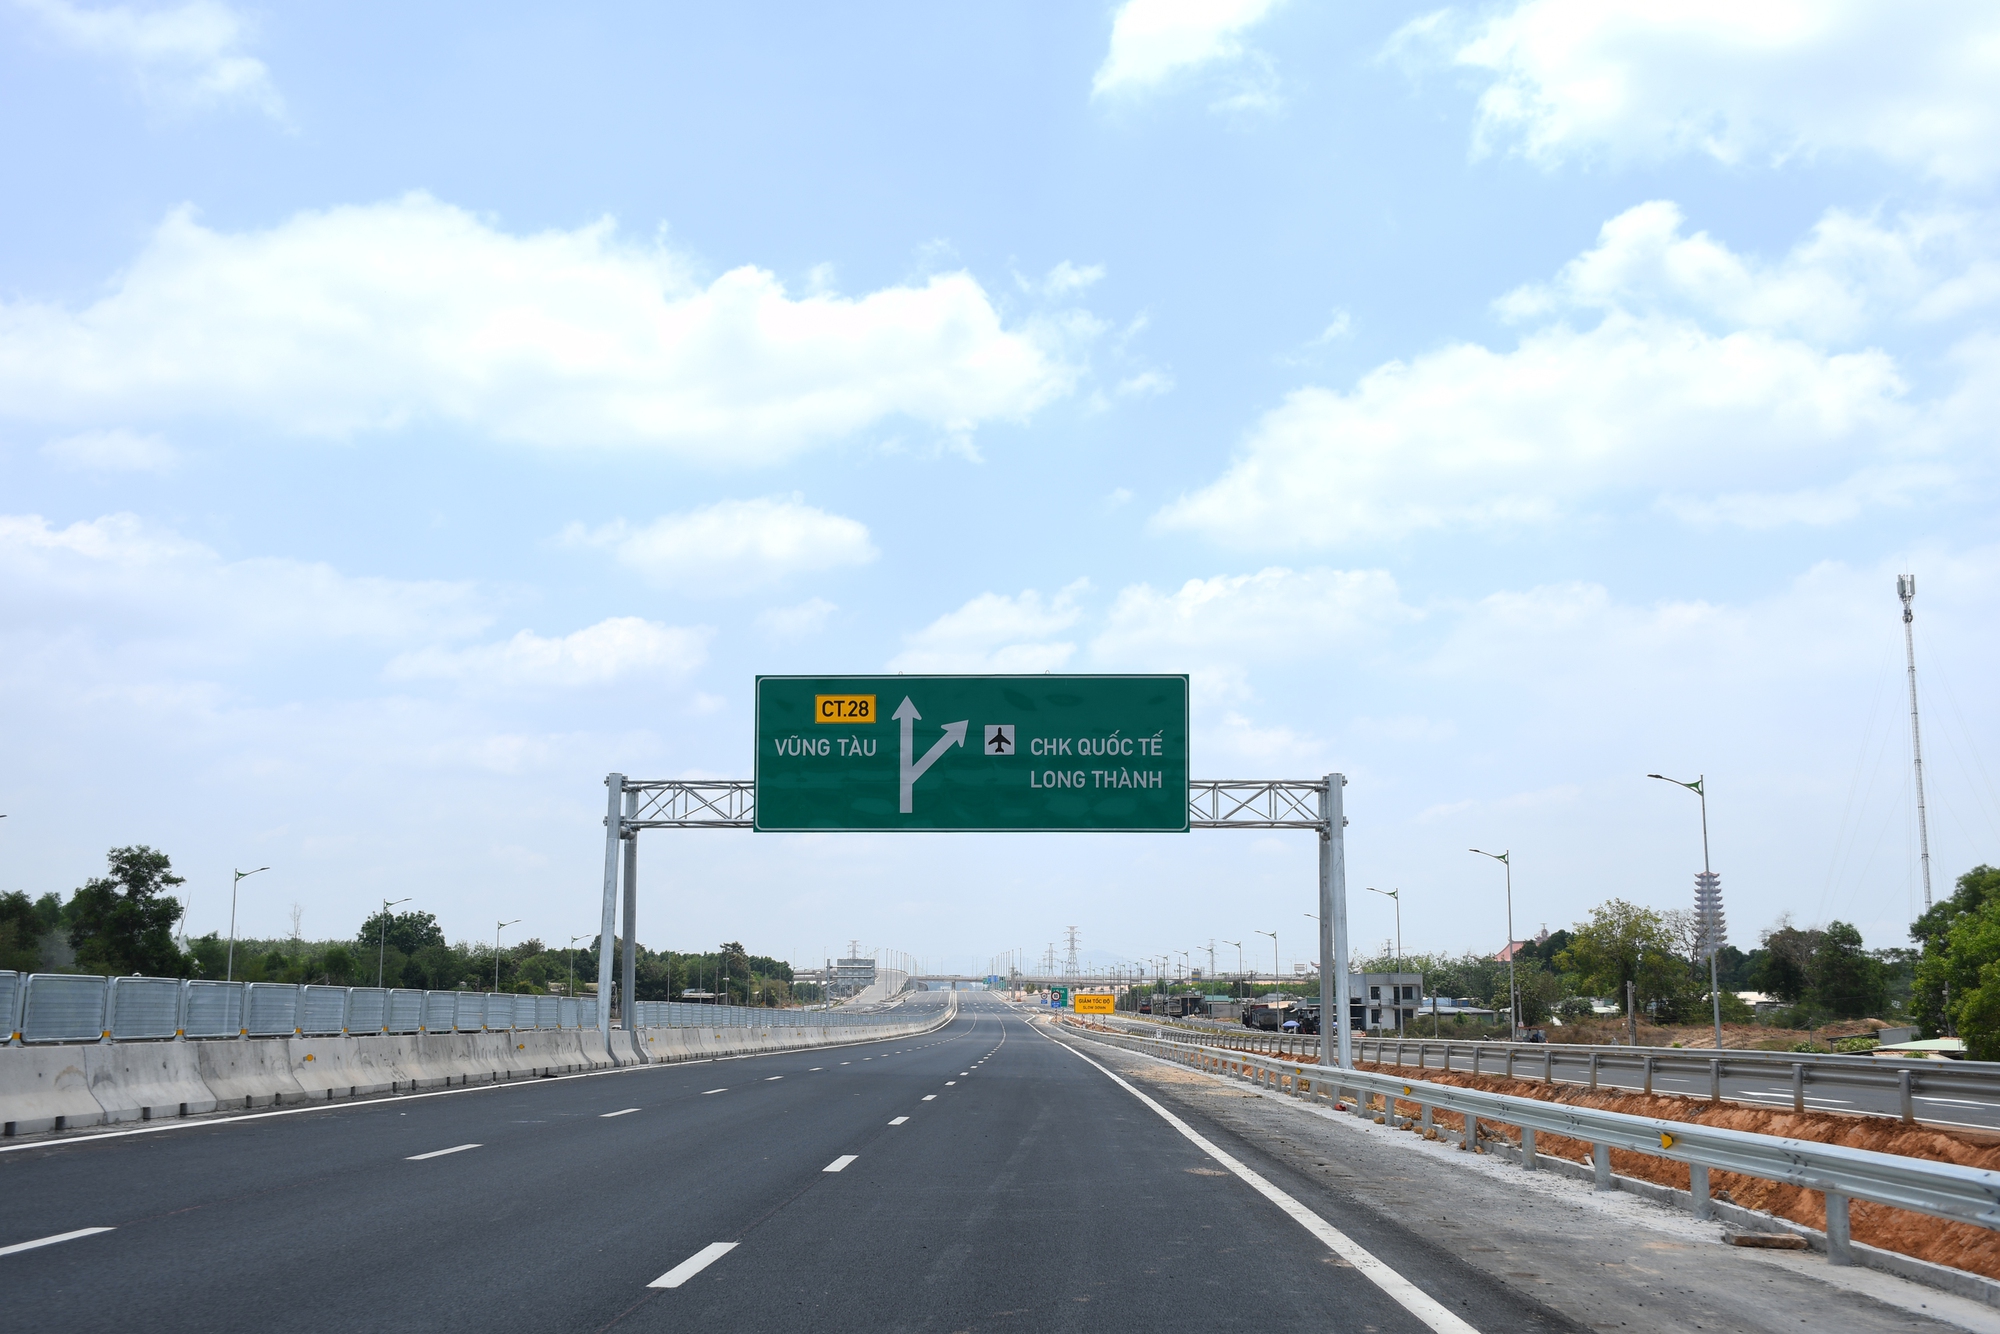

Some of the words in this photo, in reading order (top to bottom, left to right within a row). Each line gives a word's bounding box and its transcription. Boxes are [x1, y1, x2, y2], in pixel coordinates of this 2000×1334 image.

[821, 700, 869, 718] CT.28
[774, 735, 830, 757] VŨNG
[838, 734, 877, 757] TÀU
[1030, 738, 1072, 756] CHK
[1077, 729, 1133, 758] QUỐC
[1138, 729, 1163, 756] TẾ
[1030, 770, 1086, 789] LONG
[1091, 766, 1162, 789] THÀNH
